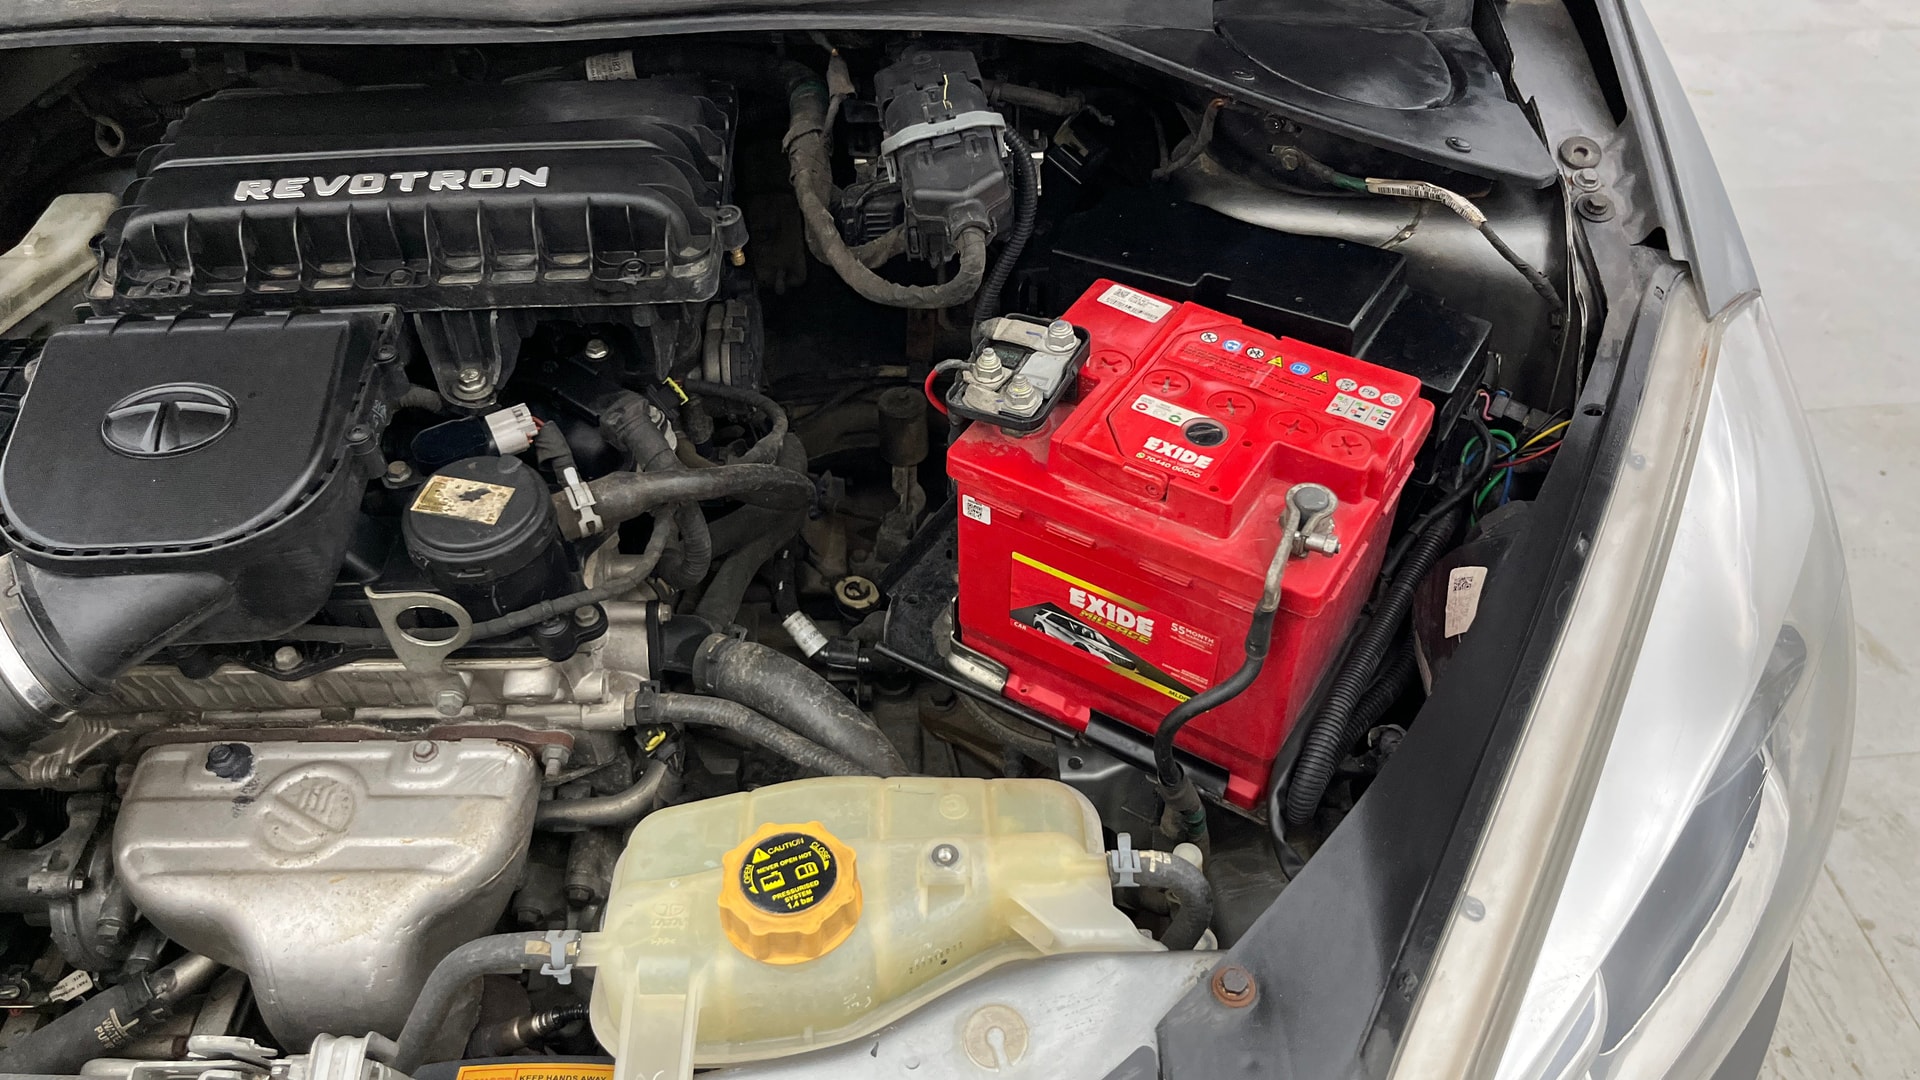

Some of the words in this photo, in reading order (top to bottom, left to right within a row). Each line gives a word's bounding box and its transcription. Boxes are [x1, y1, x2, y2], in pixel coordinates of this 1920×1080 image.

[233, 166, 549, 201] REVOTRON
[1362, 387, 1376, 397] Pb
[1143, 436, 1215, 469] EXIDE
[1145, 455, 1172, 468] 70440
[1171, 465, 1201, 479] 00000
[1069, 587, 1155, 638] EXIDE
[1013, 621, 1027, 631] CAR
[1080, 609, 1152, 645] MILEAGE
[1170, 622, 1186, 635] 55
[1185, 628, 1215, 644] MONTH
[768, 838, 804, 854] CAUTION
[810, 841, 831, 862] CLOSE
[757, 863, 779, 874] NEVER
[780, 856, 798, 866] OPEN
[798, 850, 812, 860] HOT
[743, 864, 751, 884] OPEN
[772, 880, 819, 901] PRESSURISED
[785, 889, 812, 902] SYSTEM
[787, 900, 800, 910] 1.4
[800, 895, 814, 906] bar
